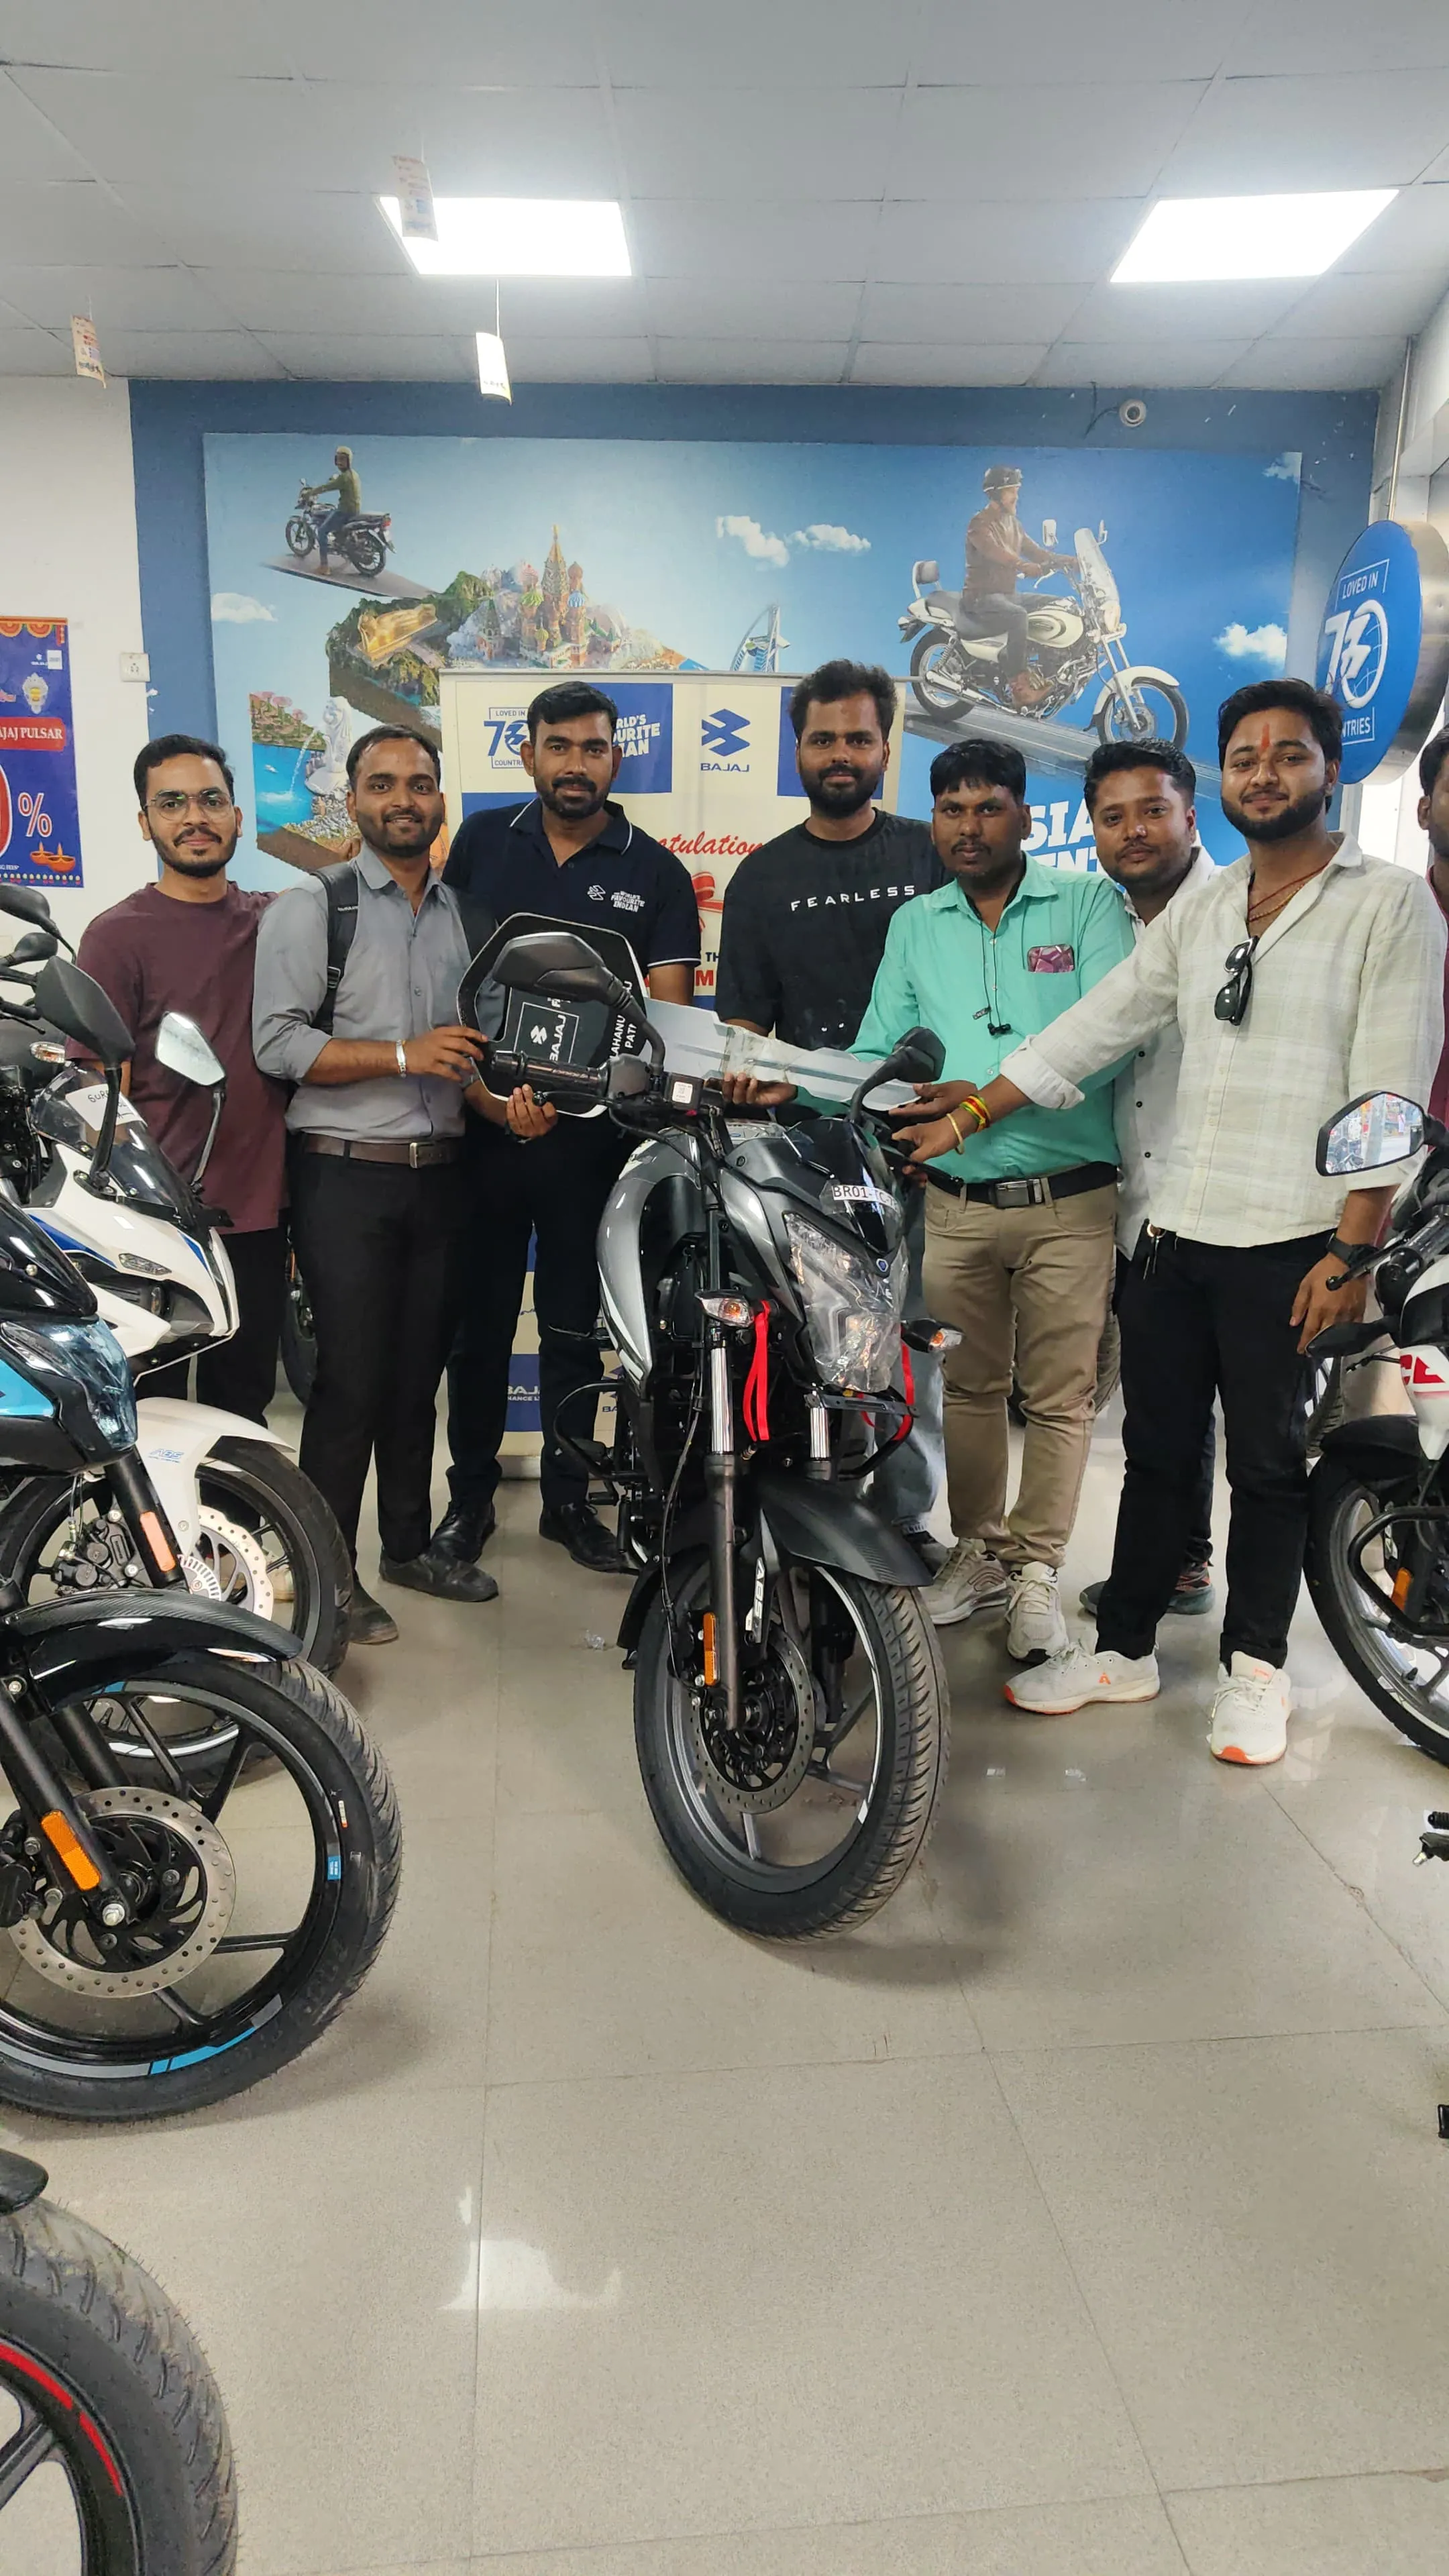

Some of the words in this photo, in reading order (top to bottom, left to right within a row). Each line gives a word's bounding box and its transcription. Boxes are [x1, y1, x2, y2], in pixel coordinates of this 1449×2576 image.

[1342, 575, 1367, 599] LOVED
[1368, 571, 1379, 590] IN
[616, 714, 647, 729] RLD'S
[1342, 717, 1371, 737] NTRIES
[20, 727, 63, 739] PULSAR
[613, 722, 661, 743] URITE
[700, 763, 750, 772] BAJAJ
[611, 895, 645, 907] FAVOURITE
[790, 885, 915, 911] FEARLESS
[705, 952, 718, 962] TH
[150, 1449, 184, 1459] ABS
[755, 1557, 765, 1620] ABS
